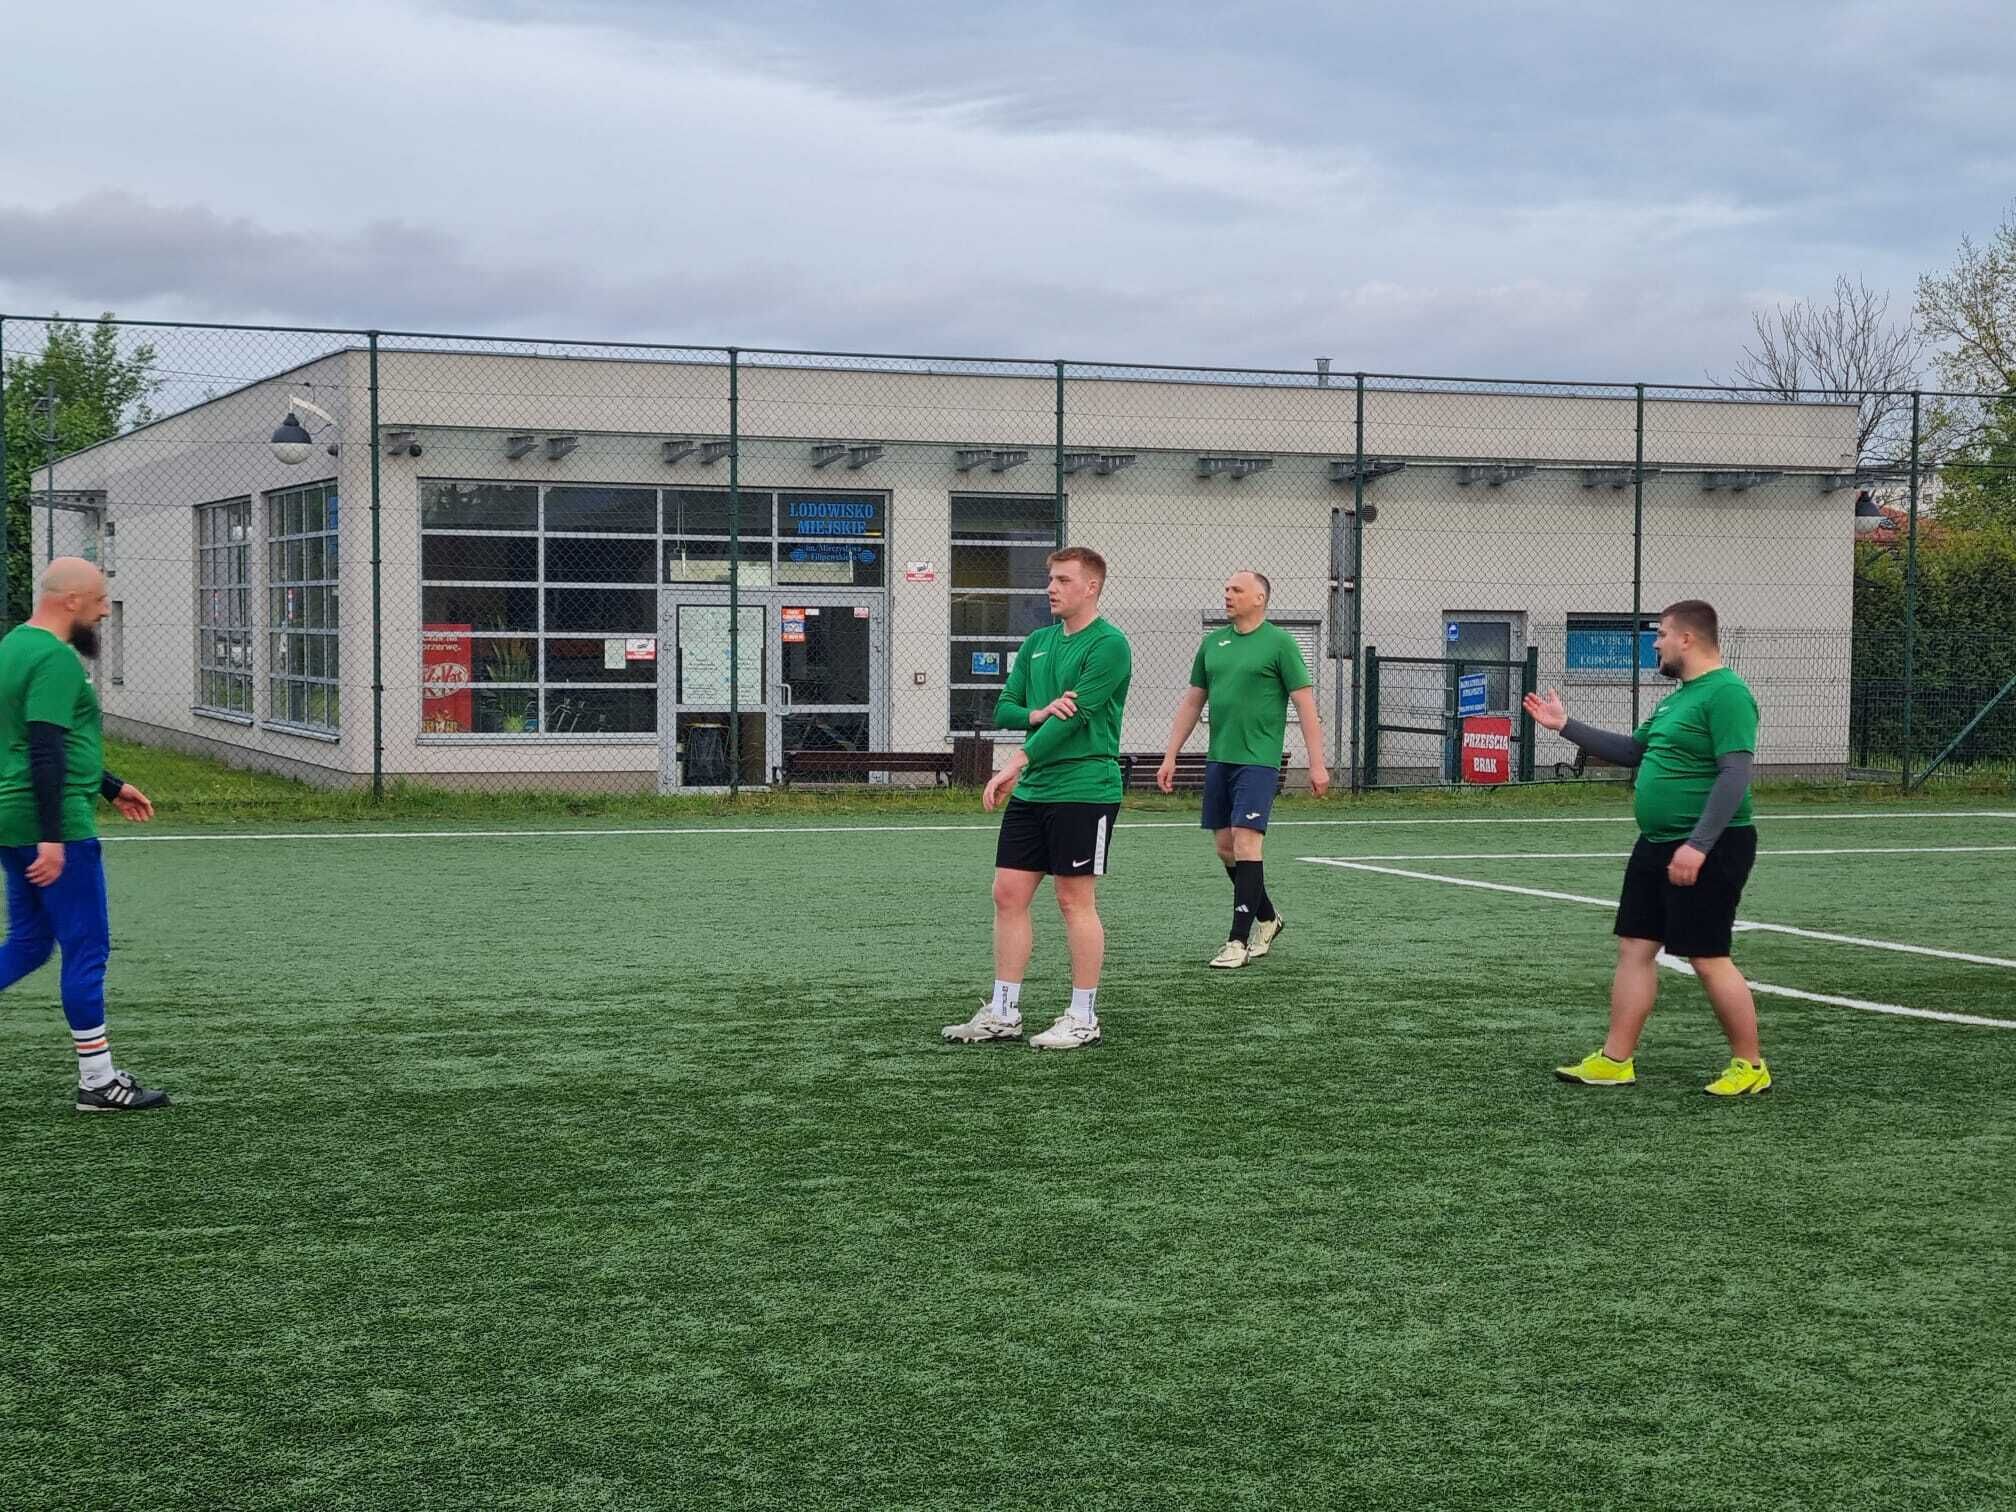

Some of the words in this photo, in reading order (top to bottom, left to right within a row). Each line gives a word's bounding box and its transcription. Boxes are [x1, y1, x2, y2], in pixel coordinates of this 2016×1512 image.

[789, 502, 874, 518] LODOWISKO
[799, 520, 866, 535] MIEJSKIE
[1464, 732, 1509, 750] PRZEJŚCIA
[1473, 757, 1498, 774] BRAK
